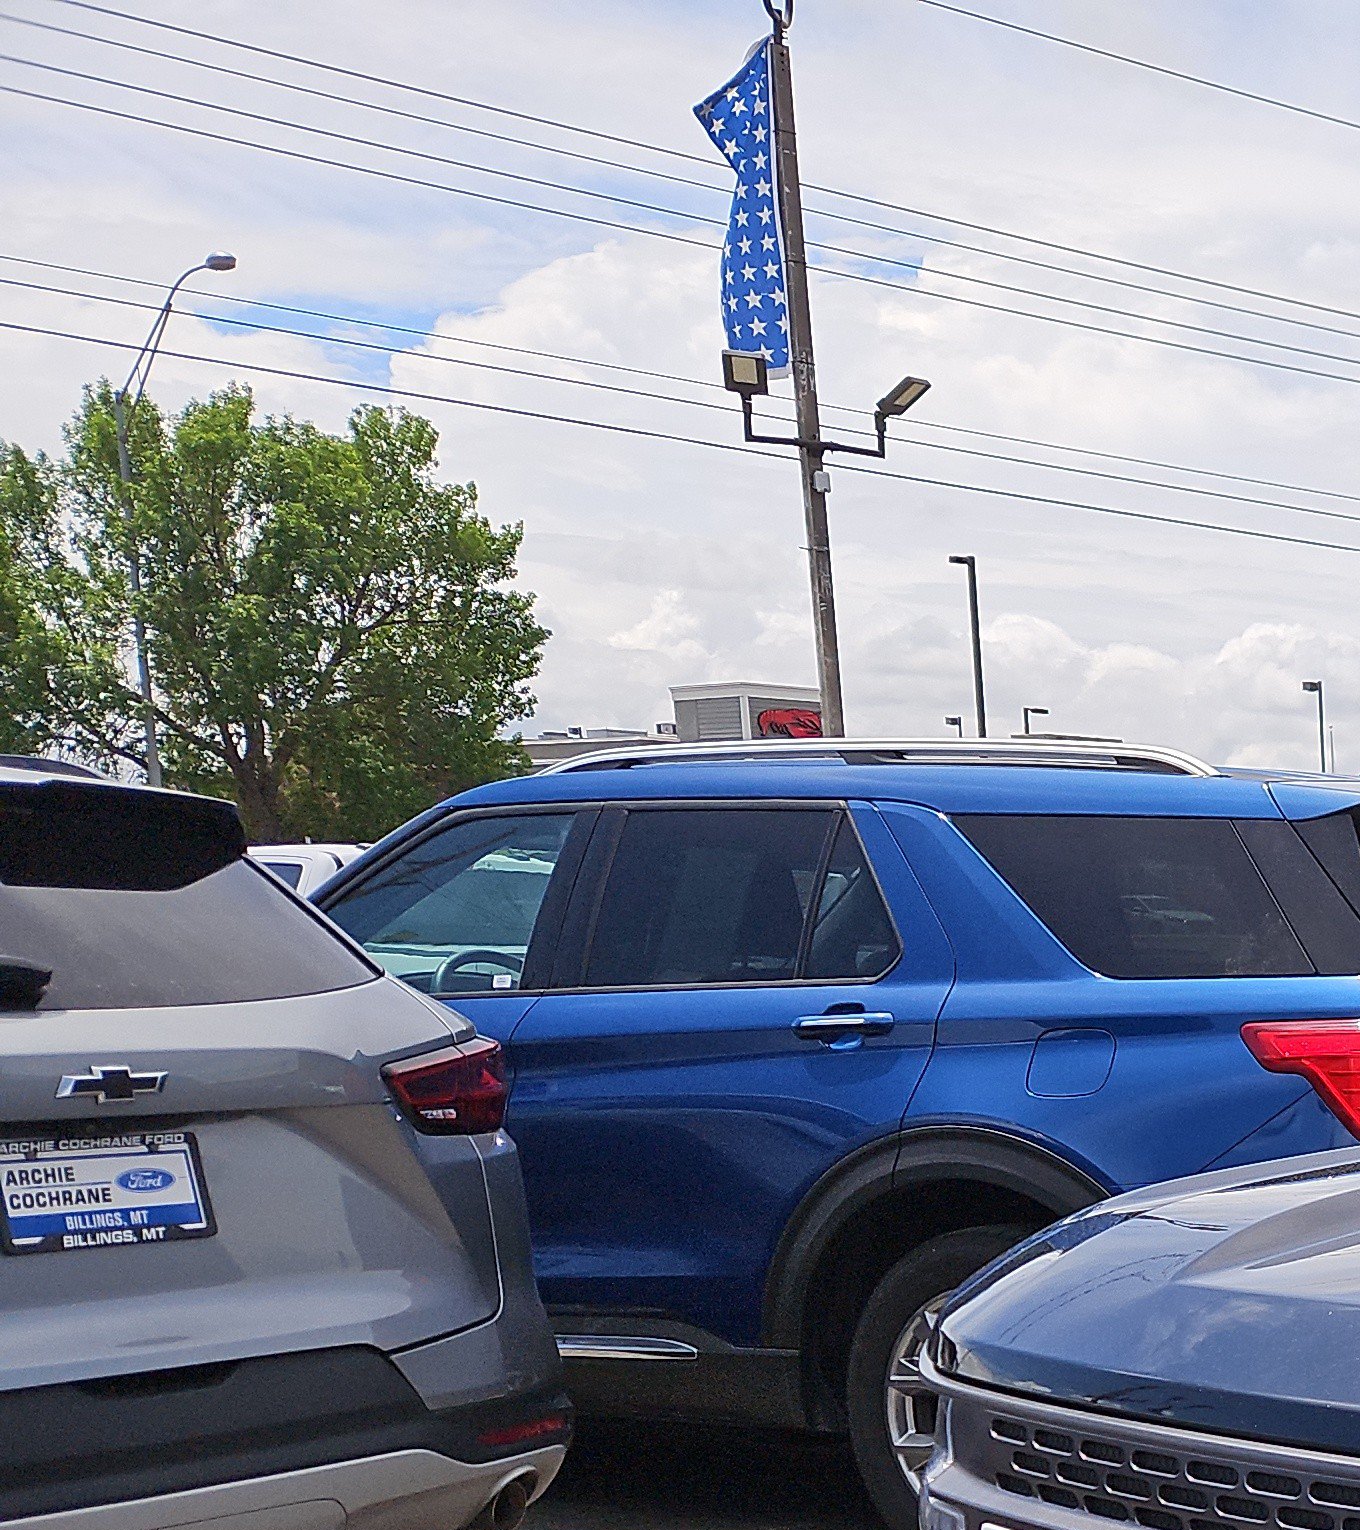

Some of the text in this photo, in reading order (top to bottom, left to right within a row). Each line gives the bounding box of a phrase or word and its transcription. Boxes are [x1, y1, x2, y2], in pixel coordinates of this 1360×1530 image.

[59, 1135, 141, 1150] COCHRANE
[145, 1133, 185, 1145] FORD
[5, 1166, 163, 1189] ARCHIE Ford
[9, 1187, 112, 1210] COCHRANE
[65, 1210, 149, 1231] BILLINGS, MT
[62, 1227, 166, 1248] BILLINGS, MT
